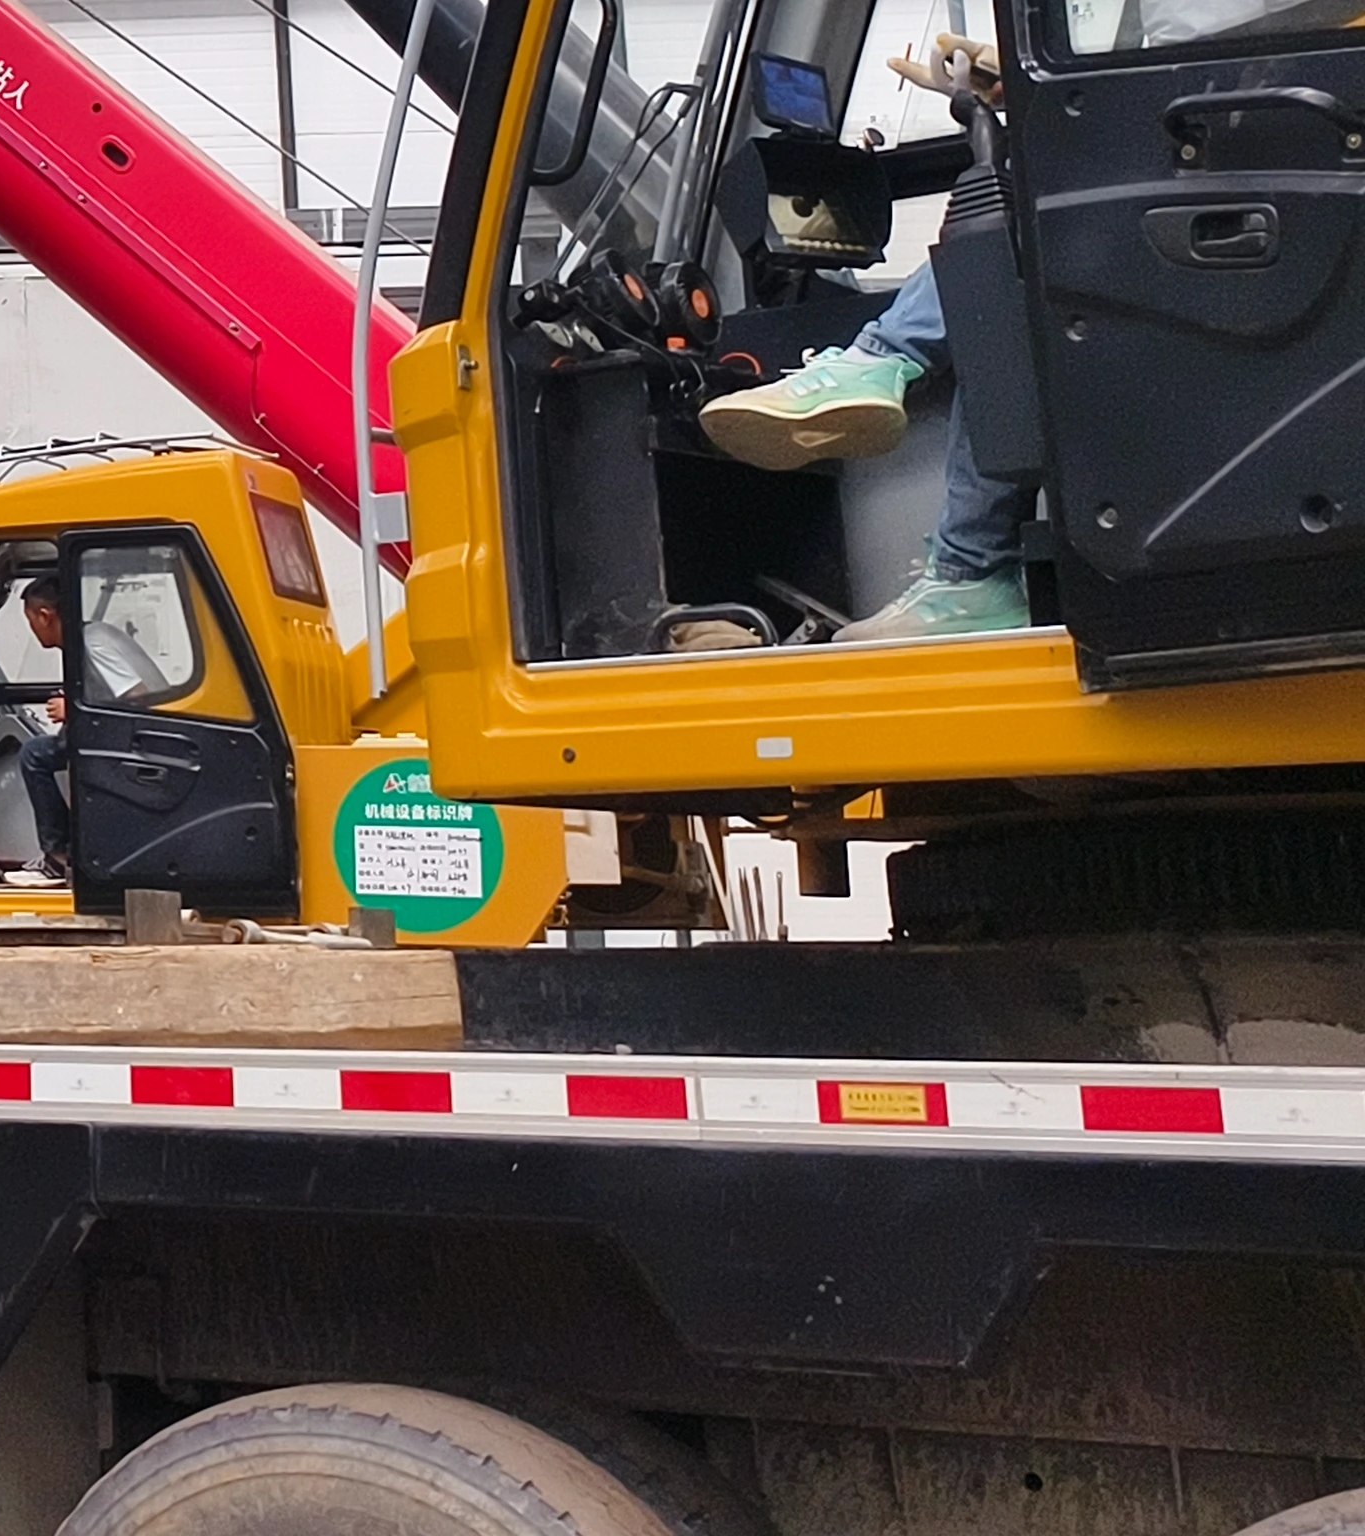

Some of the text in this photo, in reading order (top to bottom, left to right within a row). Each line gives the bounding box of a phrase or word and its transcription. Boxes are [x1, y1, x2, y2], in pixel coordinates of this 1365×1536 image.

[365, 803, 473, 821] 机械设备标识牌
